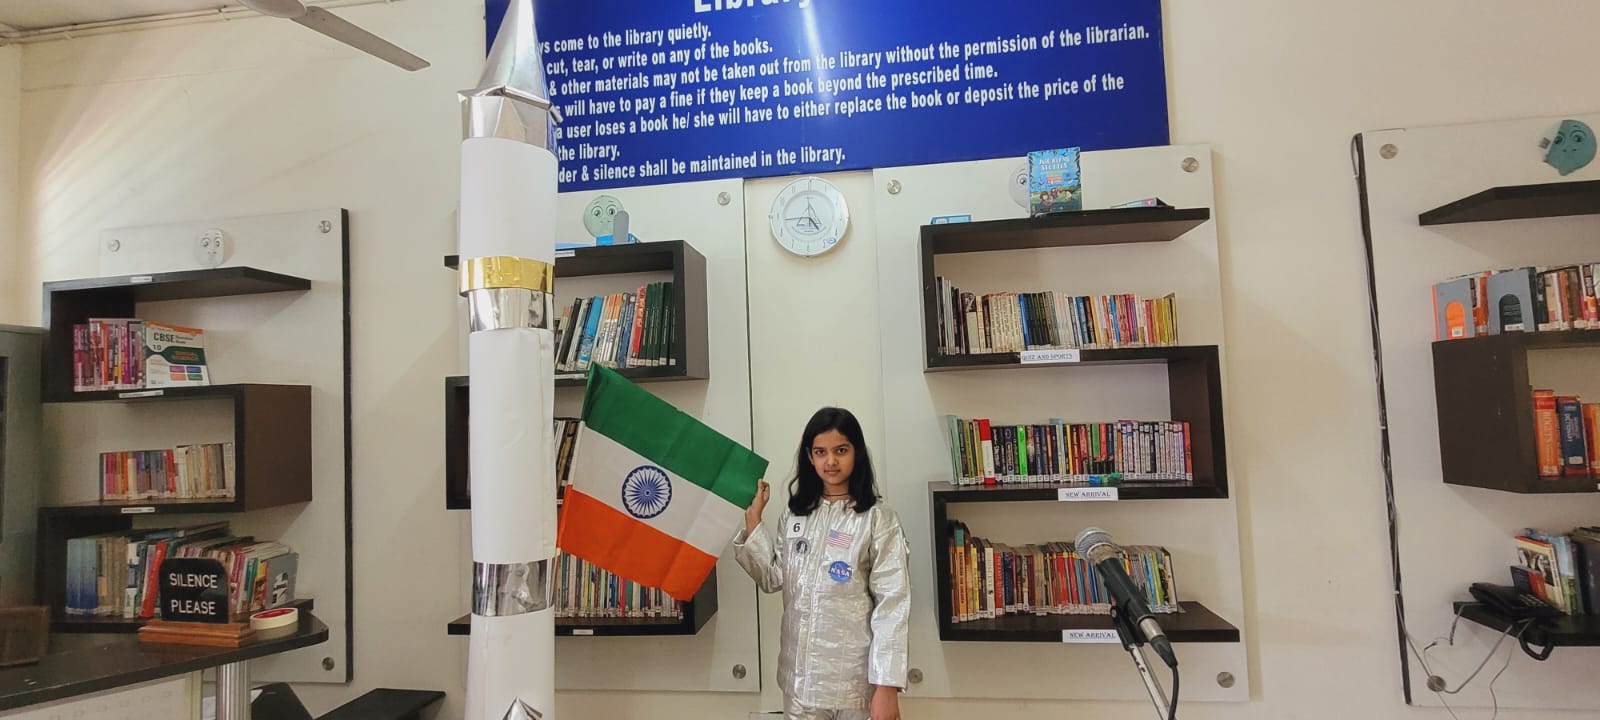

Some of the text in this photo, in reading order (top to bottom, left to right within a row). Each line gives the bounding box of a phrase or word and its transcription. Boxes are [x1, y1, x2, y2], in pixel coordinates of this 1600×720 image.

[553, 38, 584, 53] come
[587, 34, 599, 50] to
[602, 31, 622, 48] the
[625, 28, 664, 47] library
[667, 21, 712, 45] quietly.
[546, 37, 773, 77] cut, tear, or write on any of the books.
[549, 23, 1149, 97] & other materials may not be taken out from the library without the permission of the librarian.
[564, 99, 585, 117] will
[589, 98, 616, 115] have
[619, 96, 631, 112] to
[635, 97, 656, 115] pay
[659, 96, 667, 109] a
[670, 90, 693, 108] fine
[696, 88, 706, 105] if
[709, 86, 736, 107] they
[740, 84, 769, 103] keep
[772, 84, 780, 98] a
[784, 78, 814, 96] book
[818, 73, 862, 96] beyond
[866, 71, 887, 89] the
[891, 64, 960, 91] prescribed
[964, 62, 998, 80] time.
[566, 124, 592, 139] user
[595, 120, 626, 136] loses
[629, 121, 637, 134] a
[640, 114, 669, 132] book
[693, 110, 715, 128] she
[718, 107, 740, 125] will
[744, 106, 773, 123] have
[776, 103, 789, 120] to
[793, 100, 831, 118] either
[835, 96, 882, 118] replace
[886, 92, 907, 110] the
[911, 89, 943, 108] book
[946, 91, 960, 105] or
[964, 82, 1014, 107] deposit
[1017, 81, 1040, 99] the
[1044, 77, 1079, 101] price
[1083, 74, 1097, 93] of
[1101, 73, 1124, 91] the
[558, 143, 620, 161] the library.
[559, 145, 846, 183] der & silence shall be maintained in the library.
[153, 332, 175, 343] CBSE
[793, 522, 801, 533] 6
[169, 572, 218, 589] SILENCE
[830, 567, 850, 577] NASA
[171, 599, 216, 615] PLEASE
